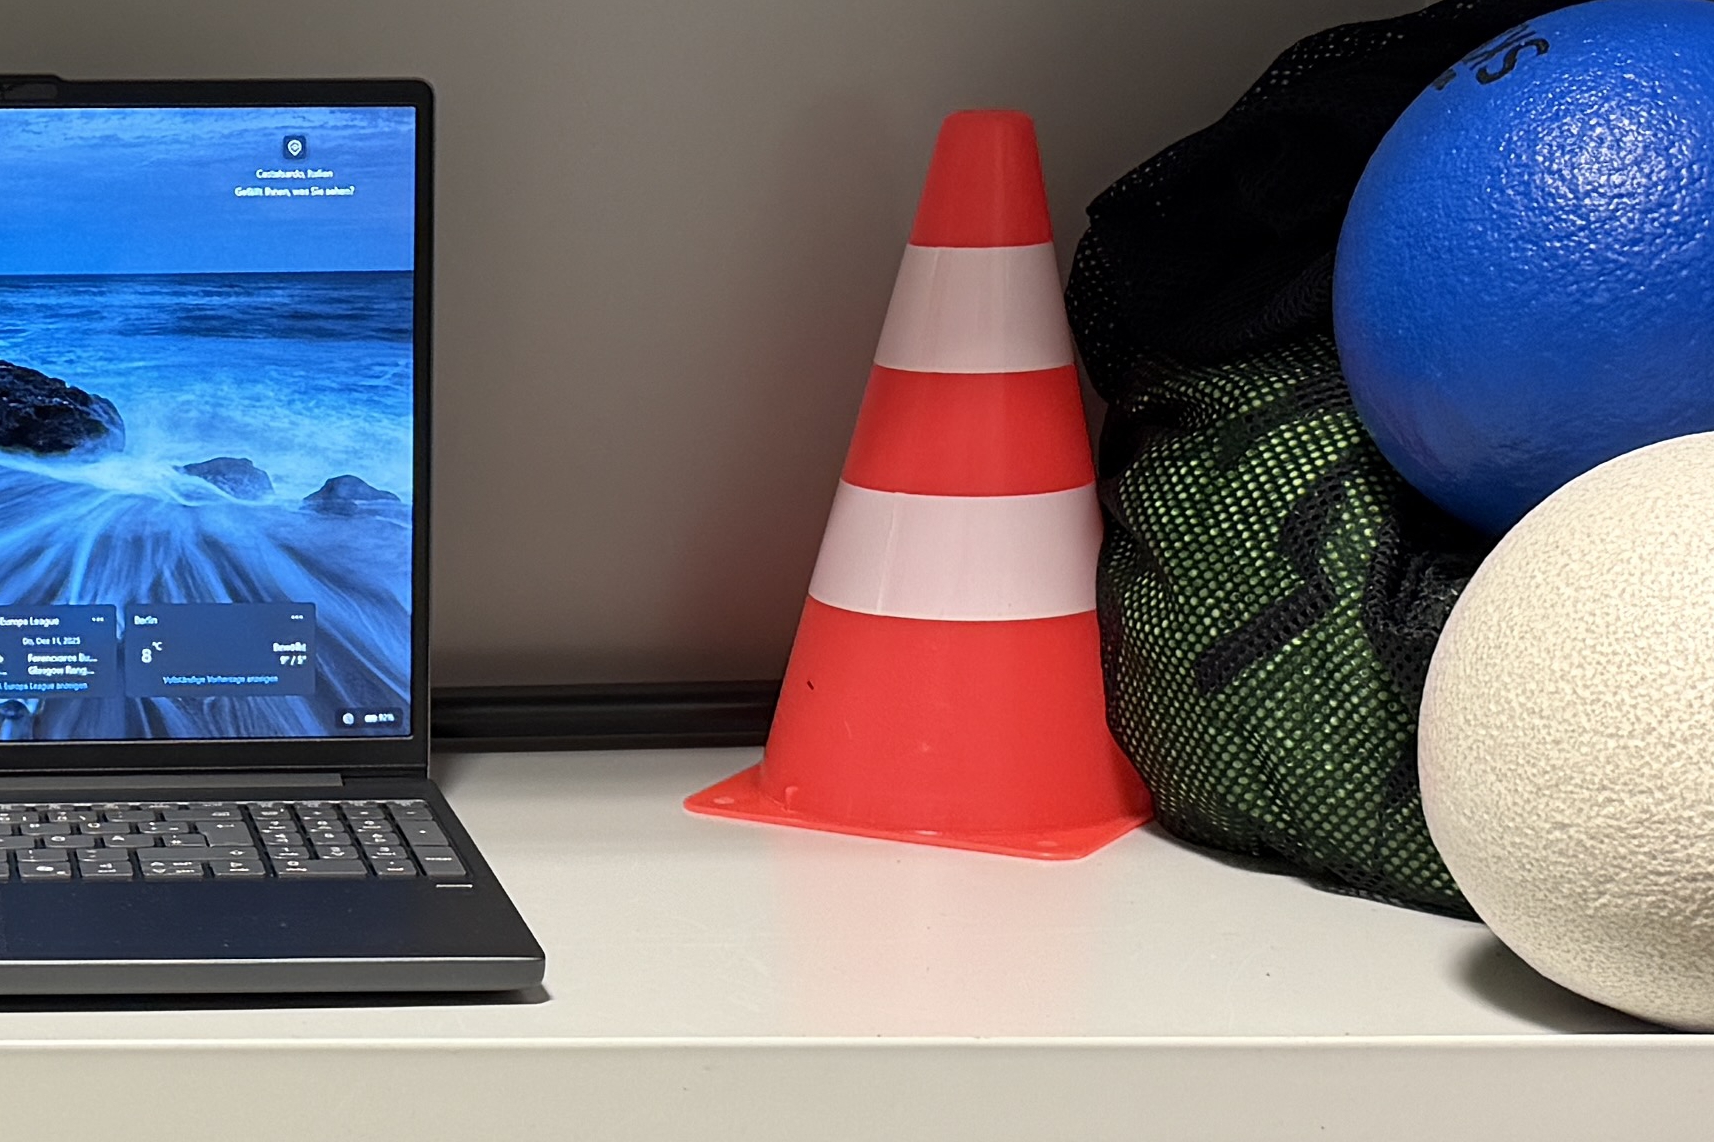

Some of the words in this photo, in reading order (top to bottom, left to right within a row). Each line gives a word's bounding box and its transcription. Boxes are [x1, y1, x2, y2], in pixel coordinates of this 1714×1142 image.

[310, 187, 324, 196] Sie
[325, 186, 355, 195] sehen?
[0, 617, 28, 627] Europa
[30, 617, 60, 627] League
[134, 615, 158, 626] Berlin
[22, 637, 35, 645] Do,
[273, 642, 307, 652] Bewölkt
[141, 648, 152, 663] 8
[28, 666, 64, 676] Glasgow
